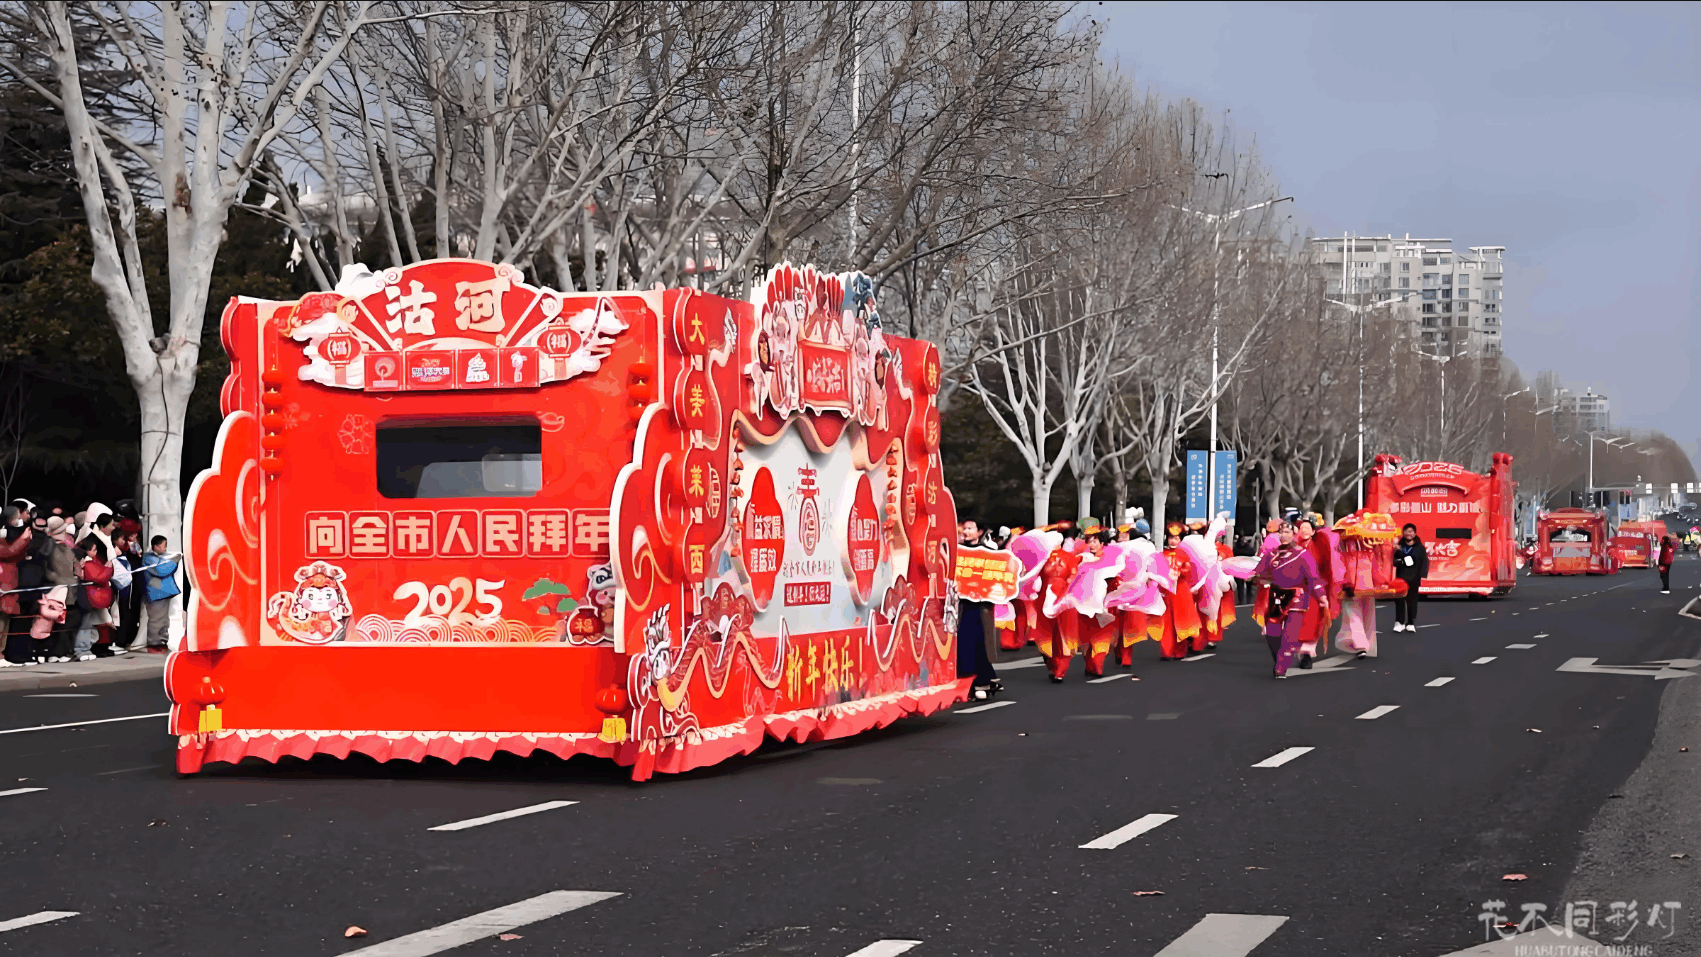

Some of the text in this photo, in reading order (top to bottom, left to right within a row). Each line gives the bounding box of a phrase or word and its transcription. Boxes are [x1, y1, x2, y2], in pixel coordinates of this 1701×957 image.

[385, 279, 510, 336] 沽河
[689, 312, 707, 575] 大美莱西
[309, 515, 609, 553] 向全市人民拜年
[393, 576, 505, 627] 2025
